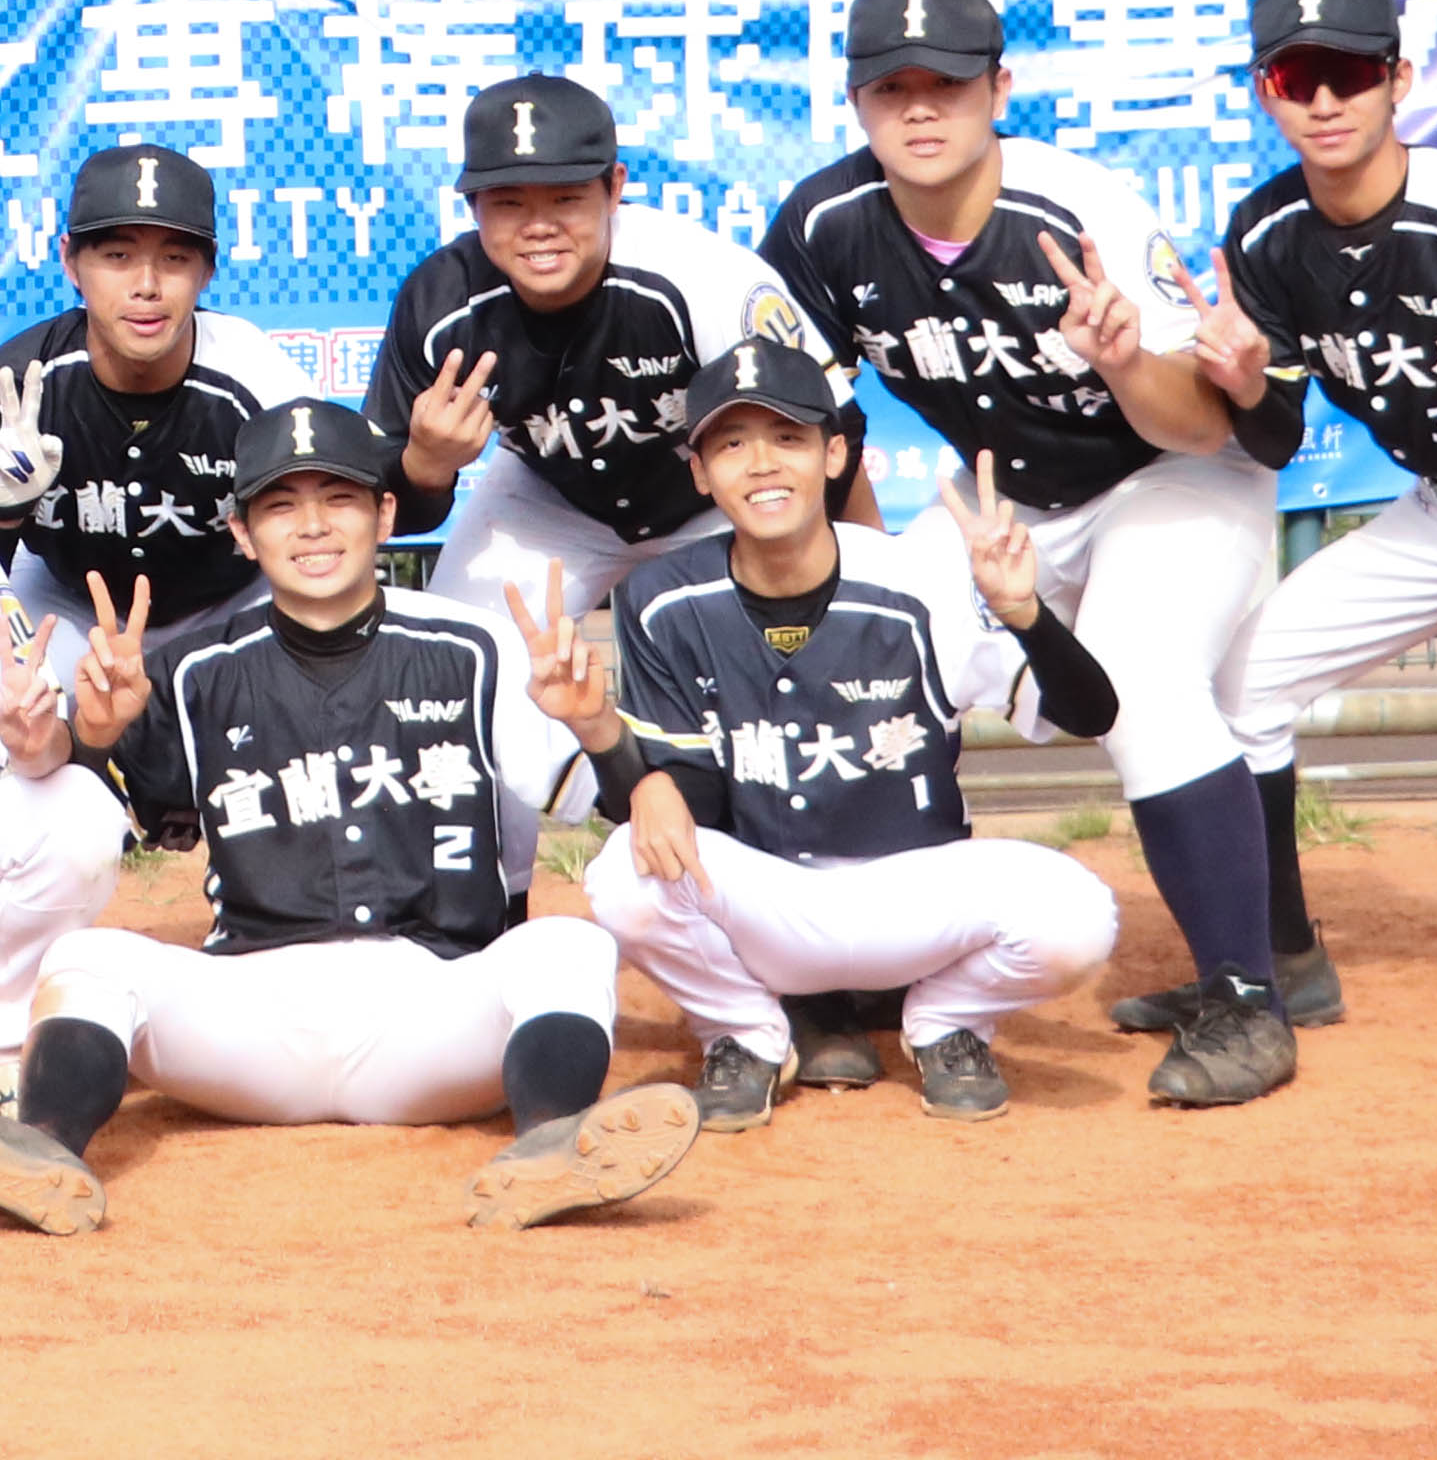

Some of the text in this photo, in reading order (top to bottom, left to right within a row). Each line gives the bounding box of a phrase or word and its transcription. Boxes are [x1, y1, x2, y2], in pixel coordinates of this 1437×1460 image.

[207, 740, 482, 839] 宜蘭大學
[433, 826, 473, 870] 2
